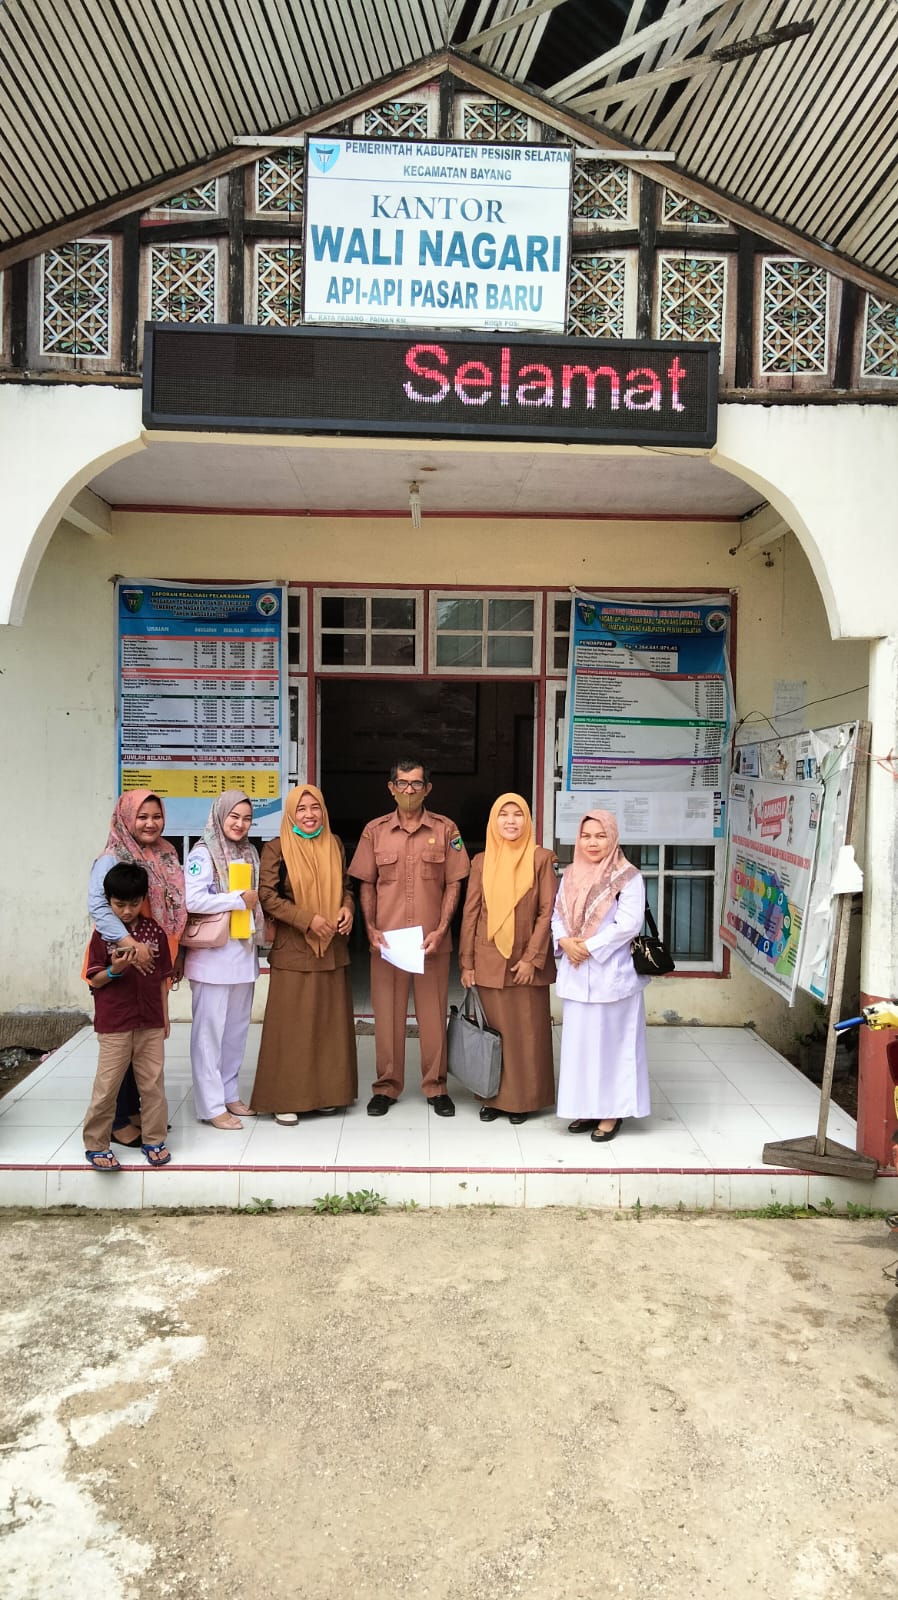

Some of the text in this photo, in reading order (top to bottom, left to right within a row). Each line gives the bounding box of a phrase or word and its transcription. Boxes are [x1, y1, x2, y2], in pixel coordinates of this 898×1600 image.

[345, 142, 571, 162] PEMERINTAH KABUPATEN PESISIR SELATAN
[403, 165, 512, 181] KECAMATAN BAYANG
[370, 194, 506, 223] KANTOR
[310, 224, 562, 273] WALI NAGARI
[326, 276, 543, 312] API-API PASAR BARU
[369, 316, 394, 324] PAINAN
[403, 343, 686, 413] Selamat
